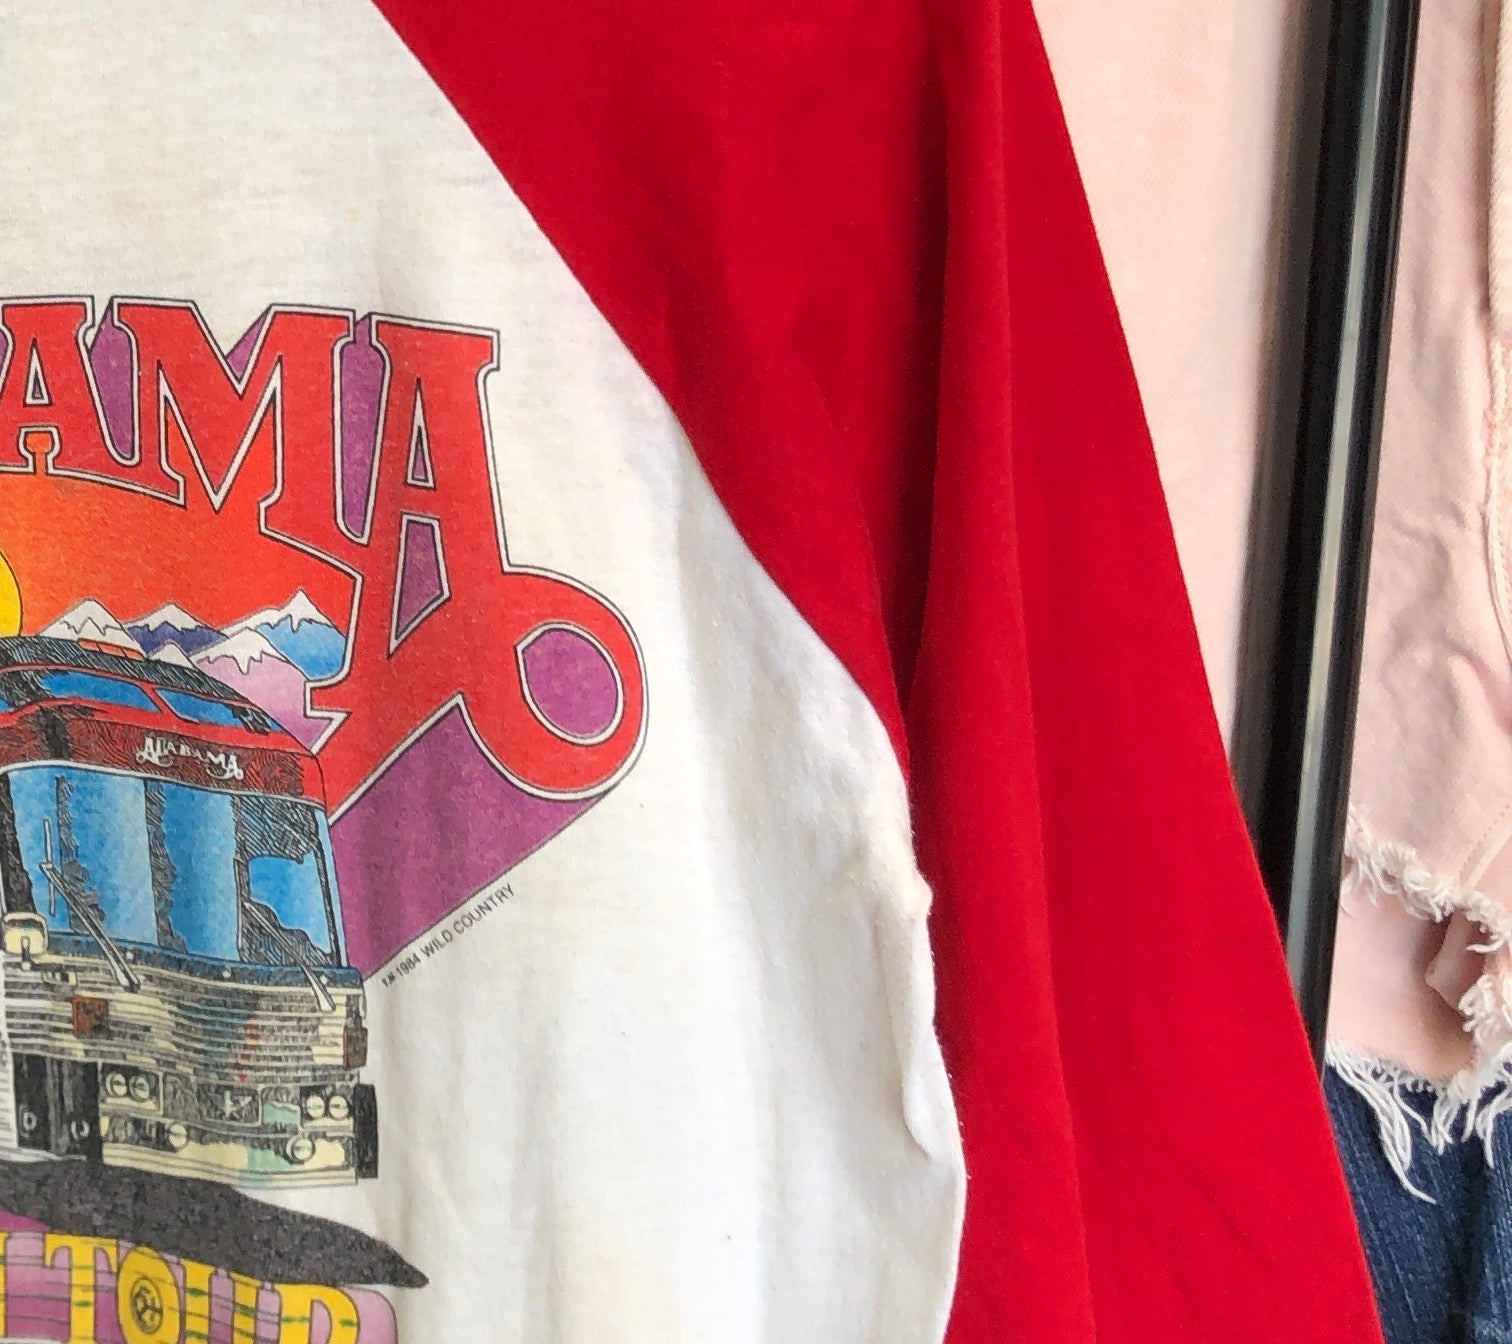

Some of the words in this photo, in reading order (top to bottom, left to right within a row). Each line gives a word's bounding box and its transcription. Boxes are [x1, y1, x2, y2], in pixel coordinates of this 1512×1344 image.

[395, 952, 422, 978] 1984
[420, 928, 454, 959] WILD
[453, 882, 516, 935] COUNTRY
